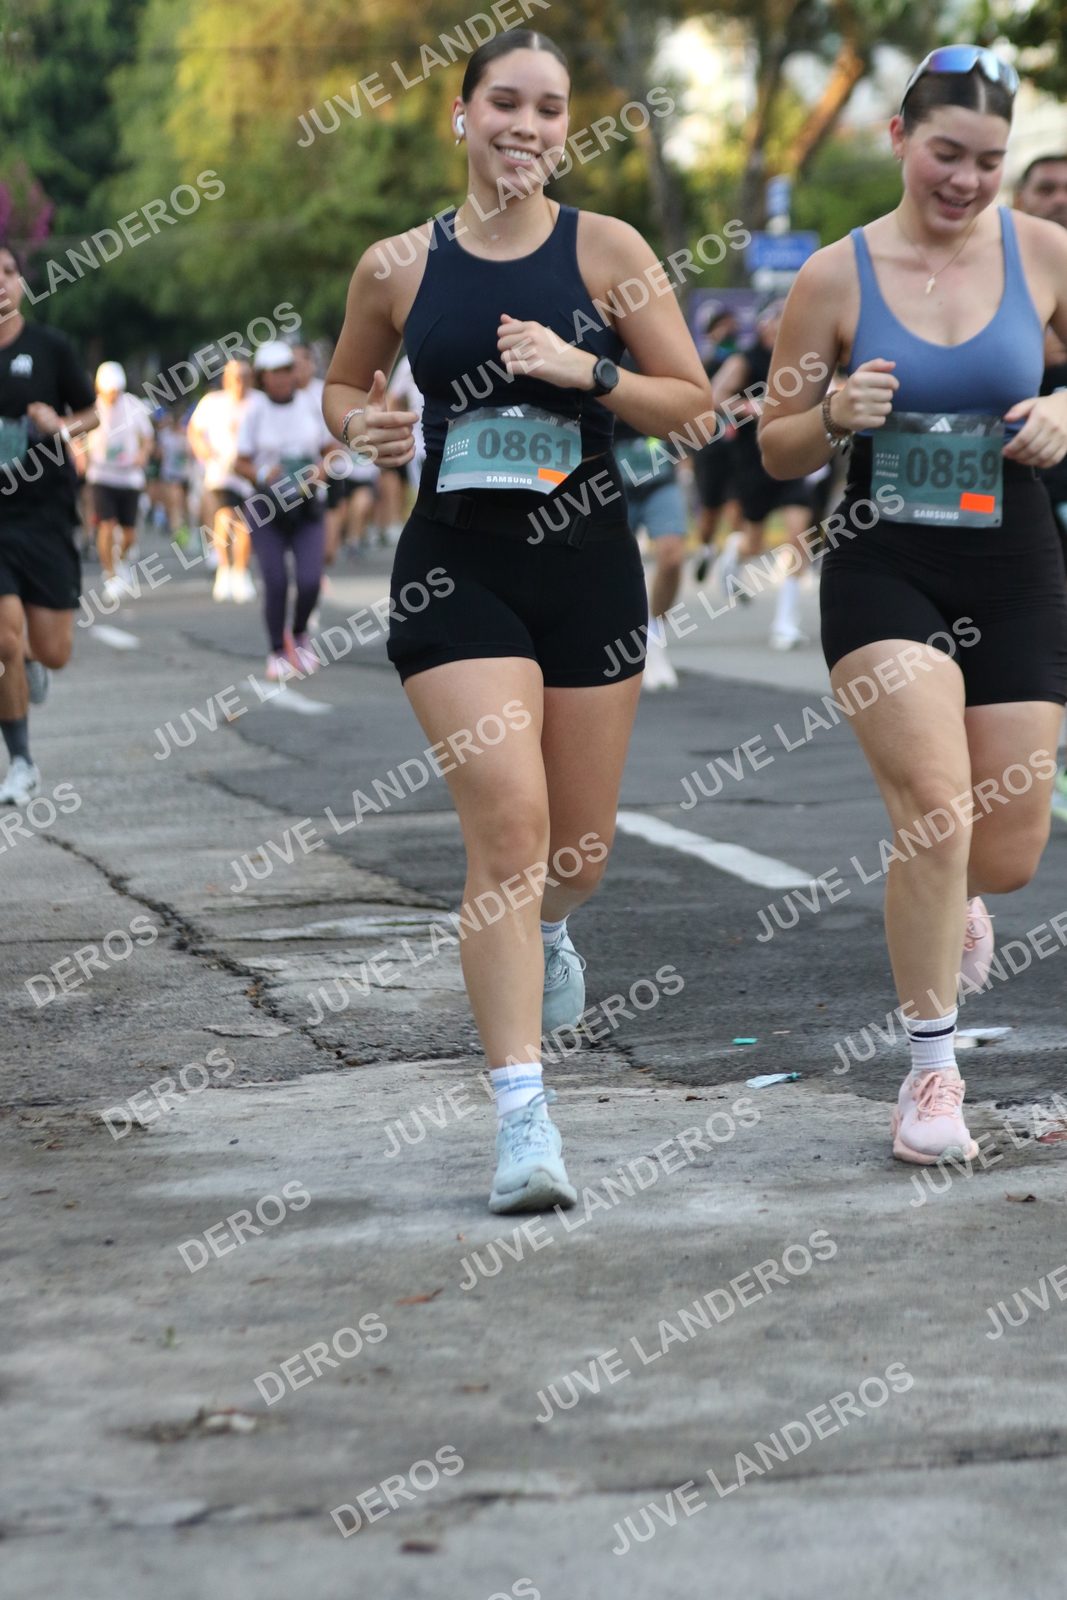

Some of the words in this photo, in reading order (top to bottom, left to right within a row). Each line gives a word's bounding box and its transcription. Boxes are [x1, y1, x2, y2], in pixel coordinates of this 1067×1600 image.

[477, 428, 573, 468] 0861
[486, 476, 532, 485] SAMSUNG
[906, 447, 999, 490] 0859
[913, 509, 960, 520] SAMSUNG
